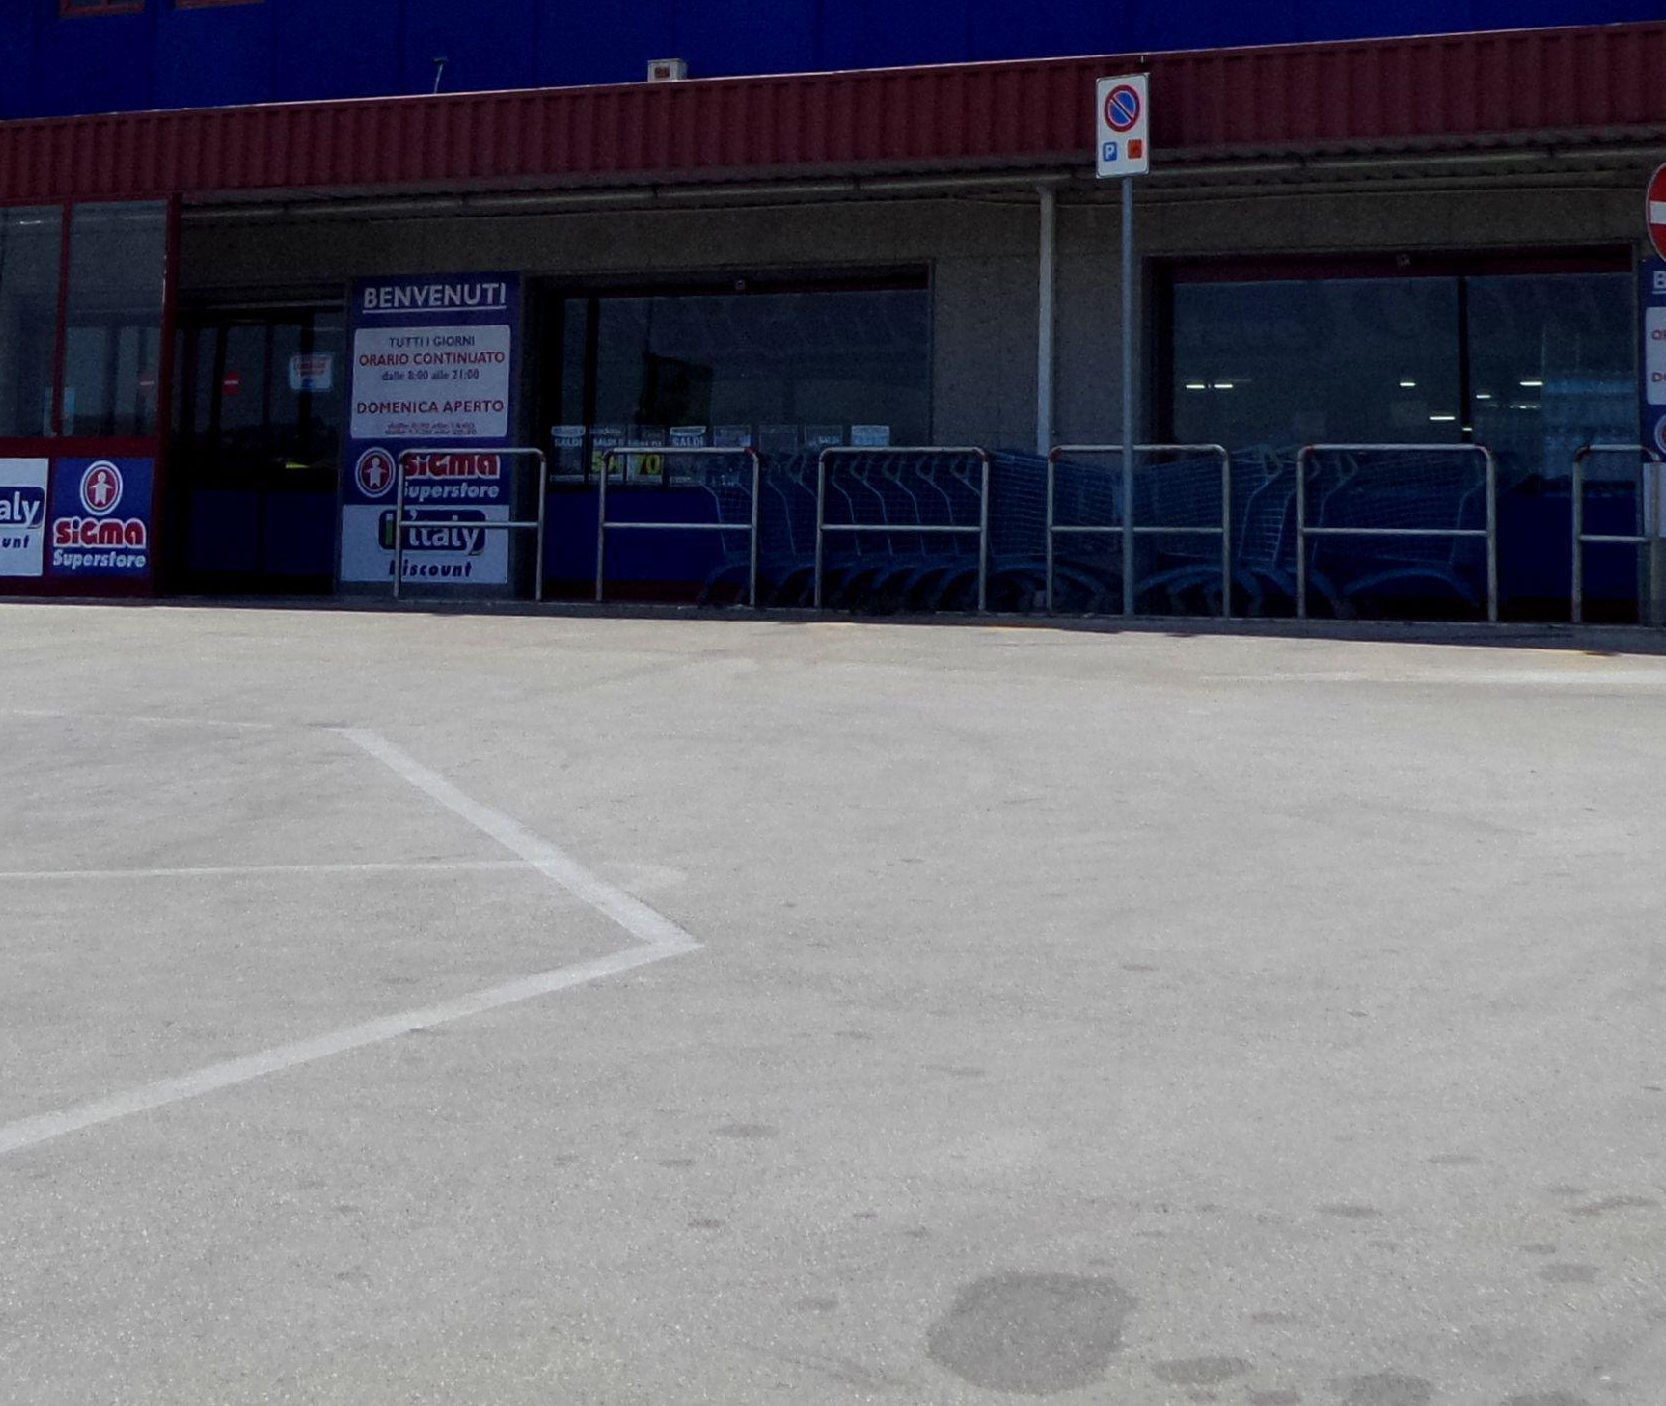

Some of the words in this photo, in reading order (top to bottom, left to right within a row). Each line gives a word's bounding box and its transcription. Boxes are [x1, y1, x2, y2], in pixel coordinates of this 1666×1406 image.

[363, 282, 507, 308] BENVENUTI
[389, 337, 425, 348] TUTTI
[433, 336, 475, 347] GIORNI
[359, 353, 409, 366] ORARIO
[413, 351, 505, 365] CONTINUATO
[357, 401, 438, 415] DOMENICA
[442, 400, 504, 413] APERTO
[52, 549, 147, 570] Superstore
